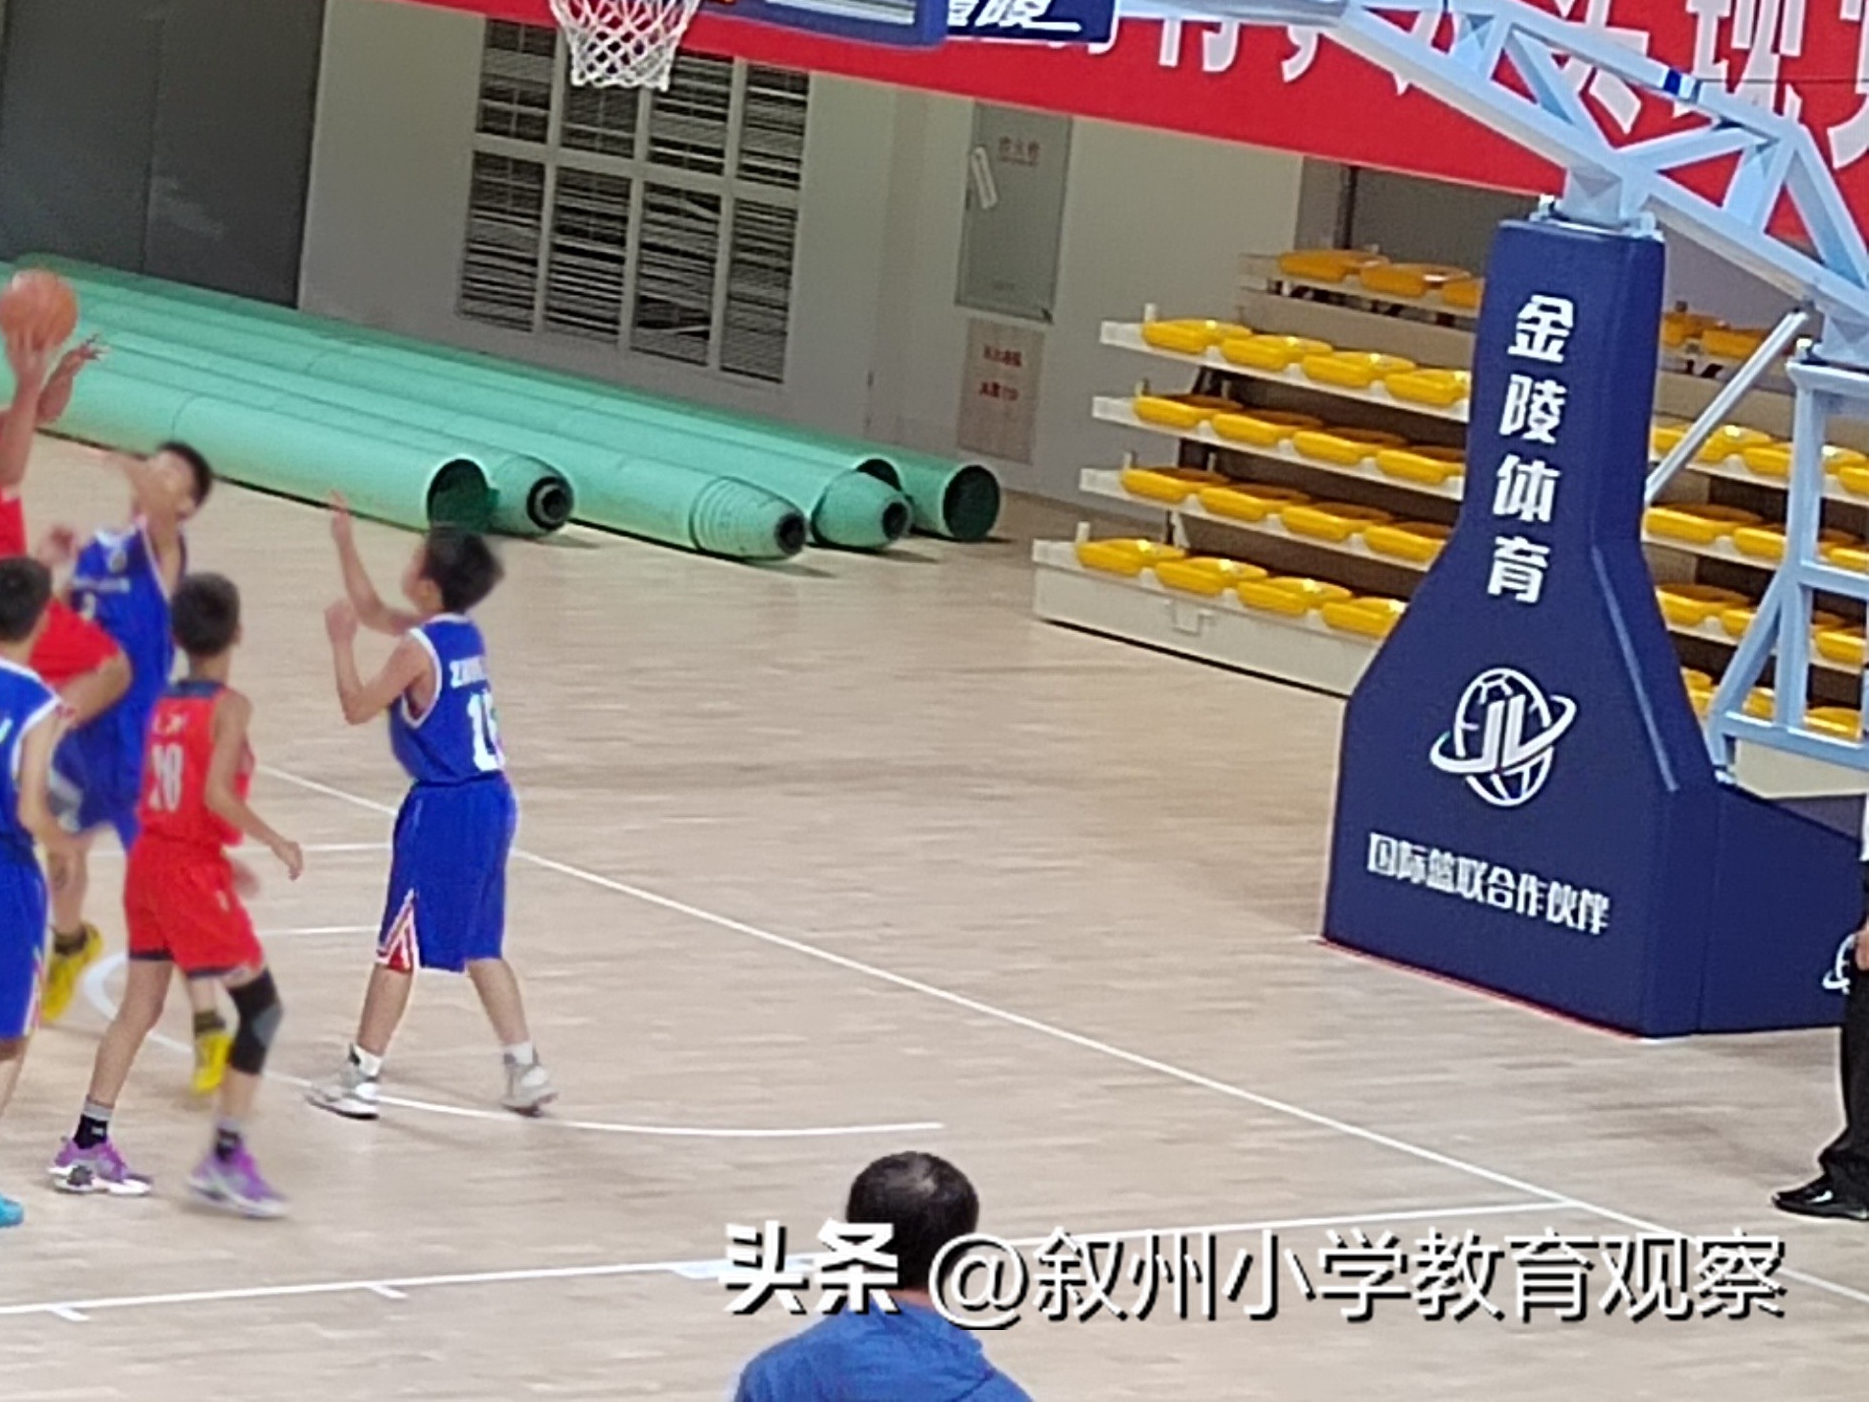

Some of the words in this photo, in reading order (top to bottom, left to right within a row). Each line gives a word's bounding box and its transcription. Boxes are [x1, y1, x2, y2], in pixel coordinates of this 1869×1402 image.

[1487, 294, 1575, 604] 金陵体育
[1366, 831, 1612, 935] 国际篮联合作伙伴
